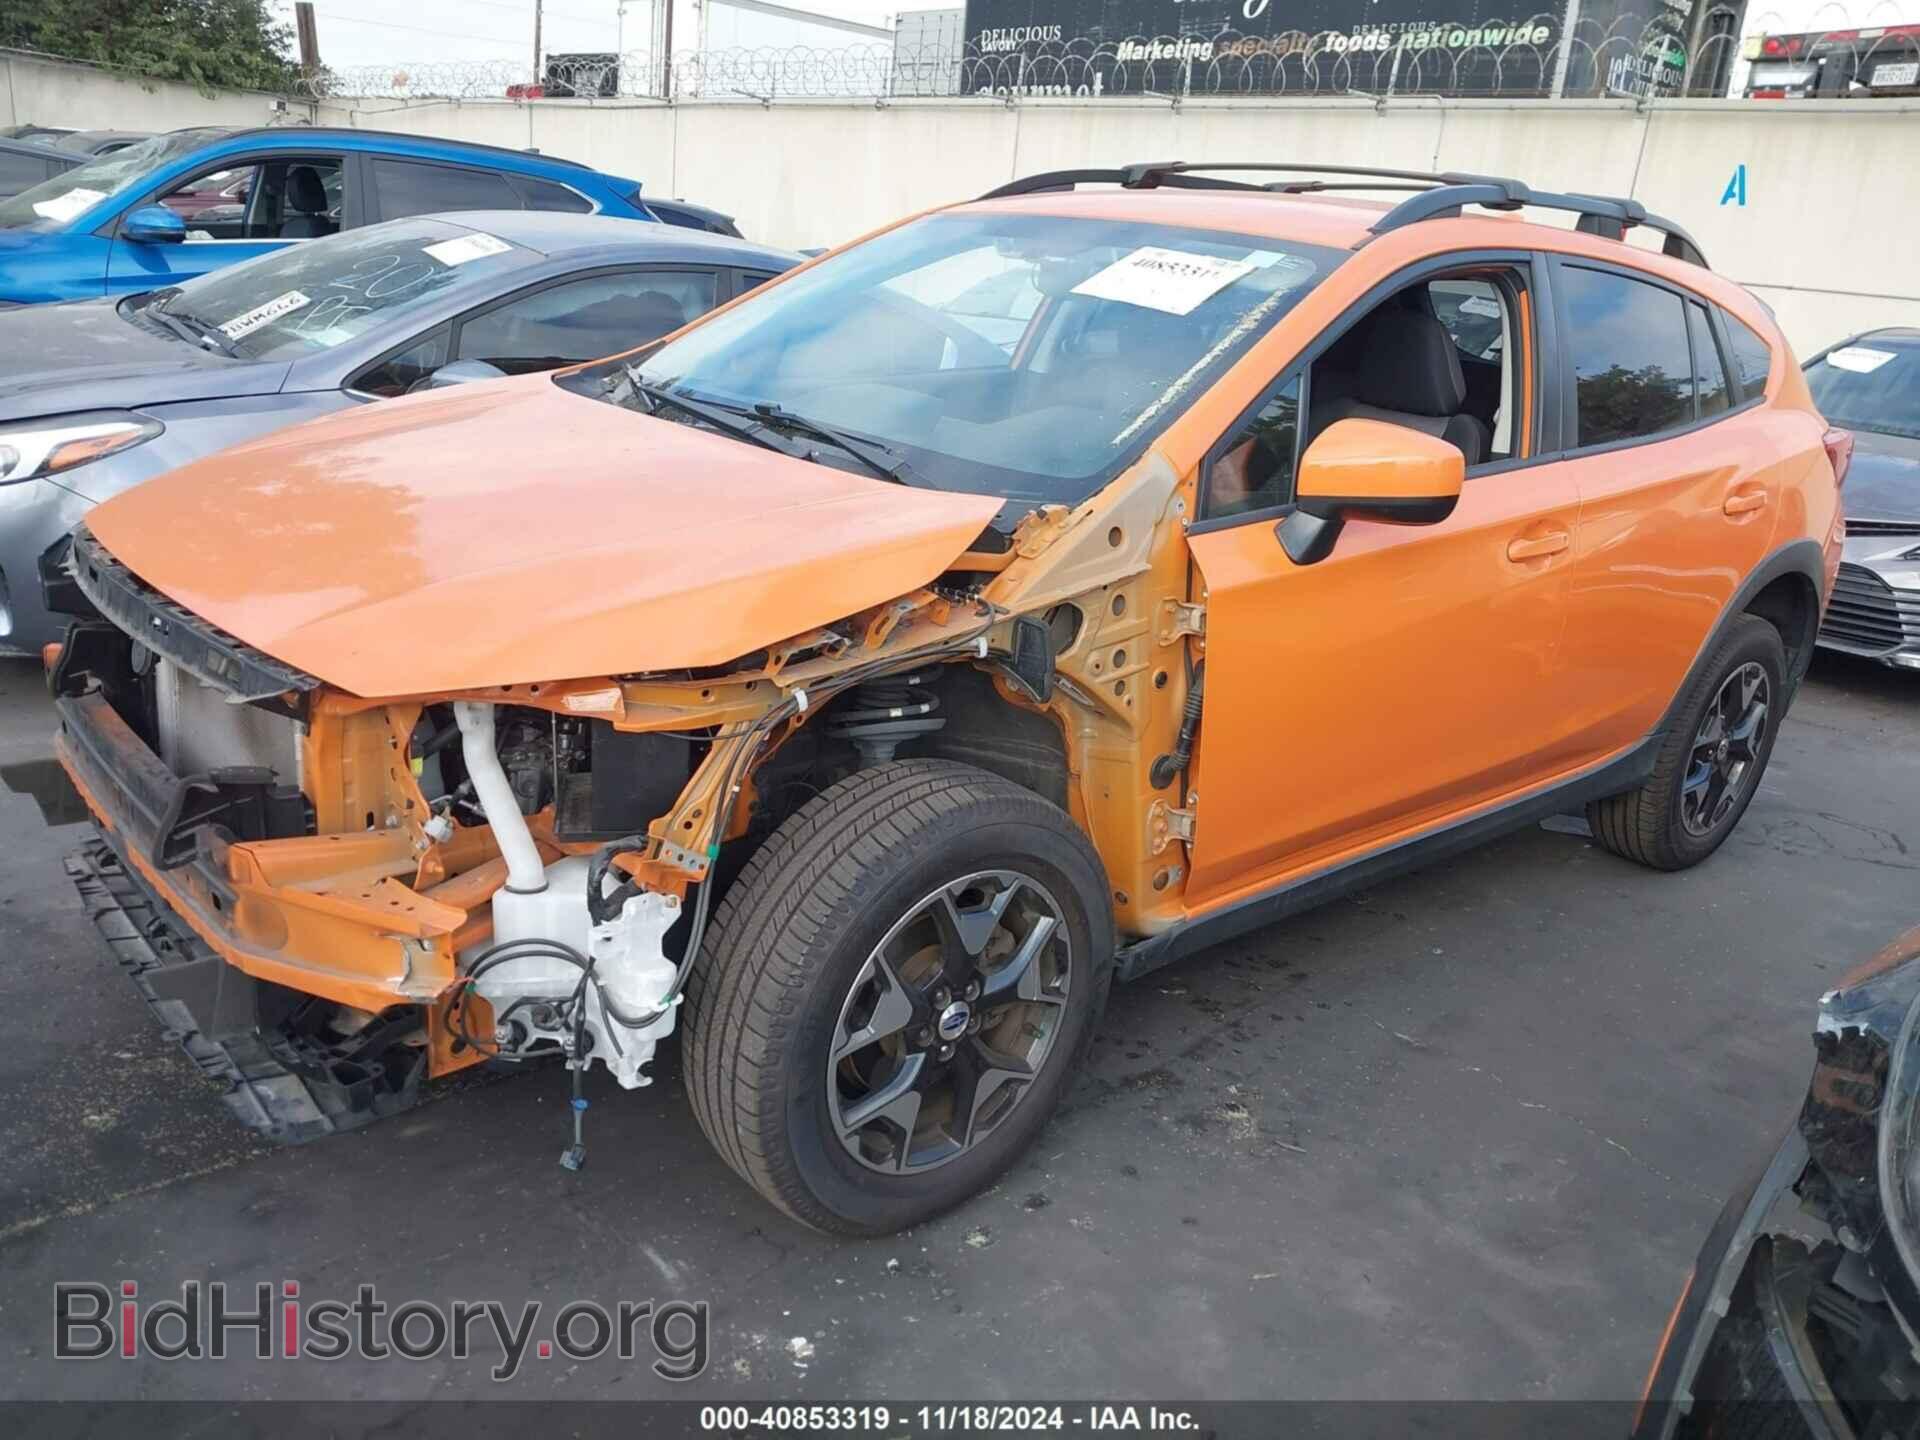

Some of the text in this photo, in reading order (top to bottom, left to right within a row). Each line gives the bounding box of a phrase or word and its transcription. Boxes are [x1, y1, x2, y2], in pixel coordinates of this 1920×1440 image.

[981, 25, 1062, 43] DELICIOUS
[1352, 21, 1437, 36] DELICIOUS
[981, 40, 1017, 52] SAVORY
[1116, 39, 1214, 62] Marketing
[1325, 30, 1391, 52] foods
[1400, 22, 1550, 49] nationwide
